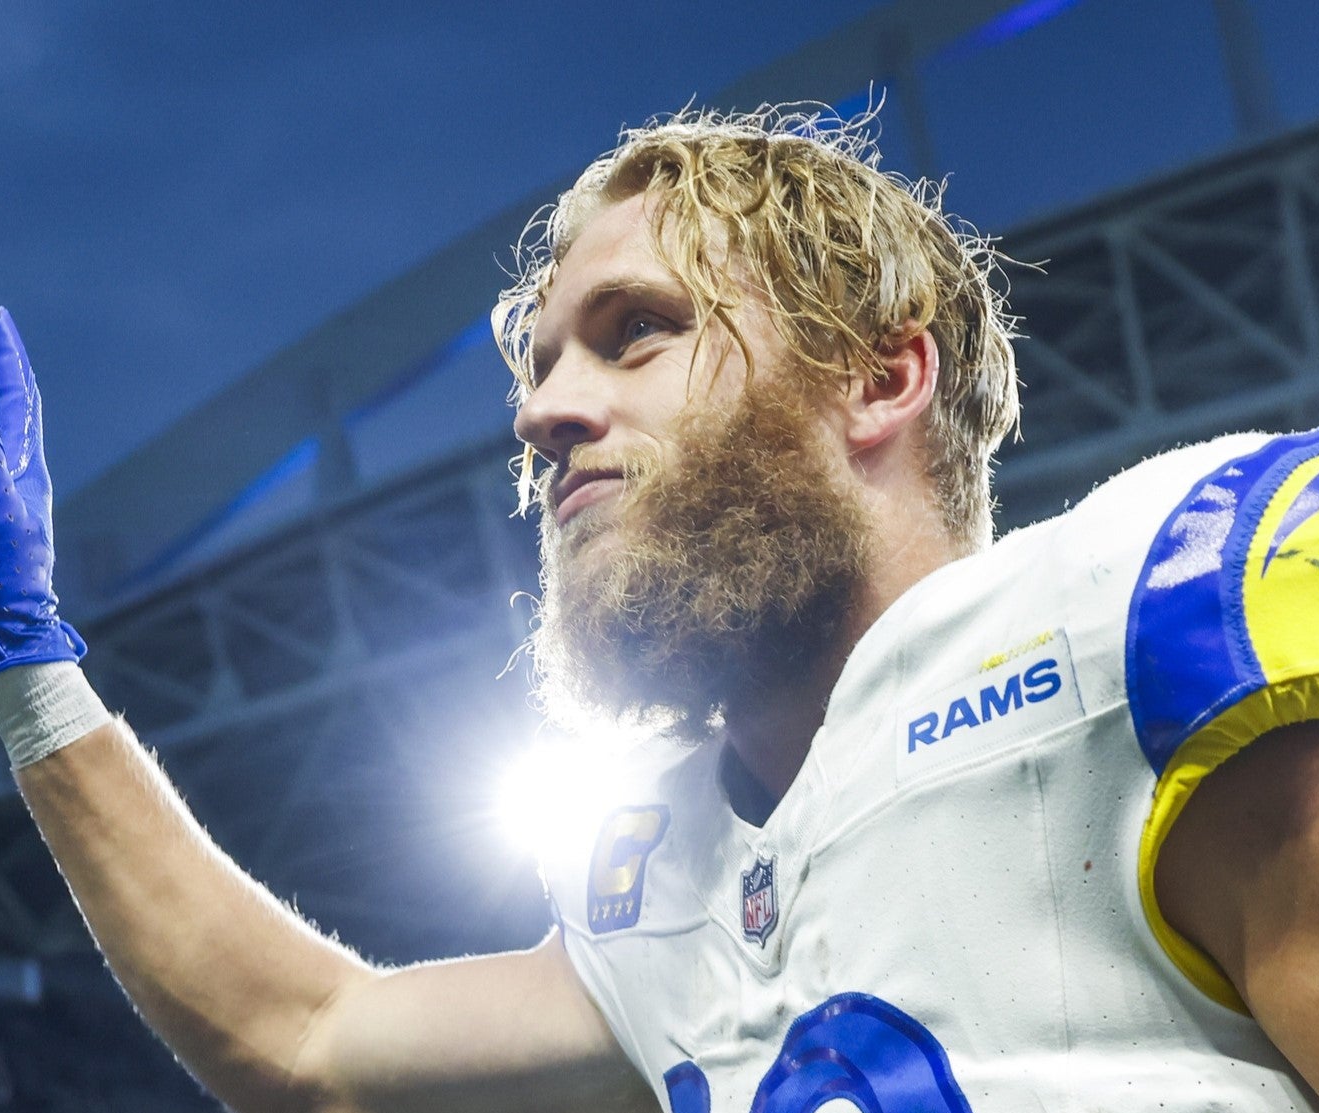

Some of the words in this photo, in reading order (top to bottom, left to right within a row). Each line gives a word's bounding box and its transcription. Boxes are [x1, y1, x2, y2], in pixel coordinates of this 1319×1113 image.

[908, 658, 1062, 754] RAMS
[594, 810, 661, 897] C
[745, 890, 772, 930] NFL
